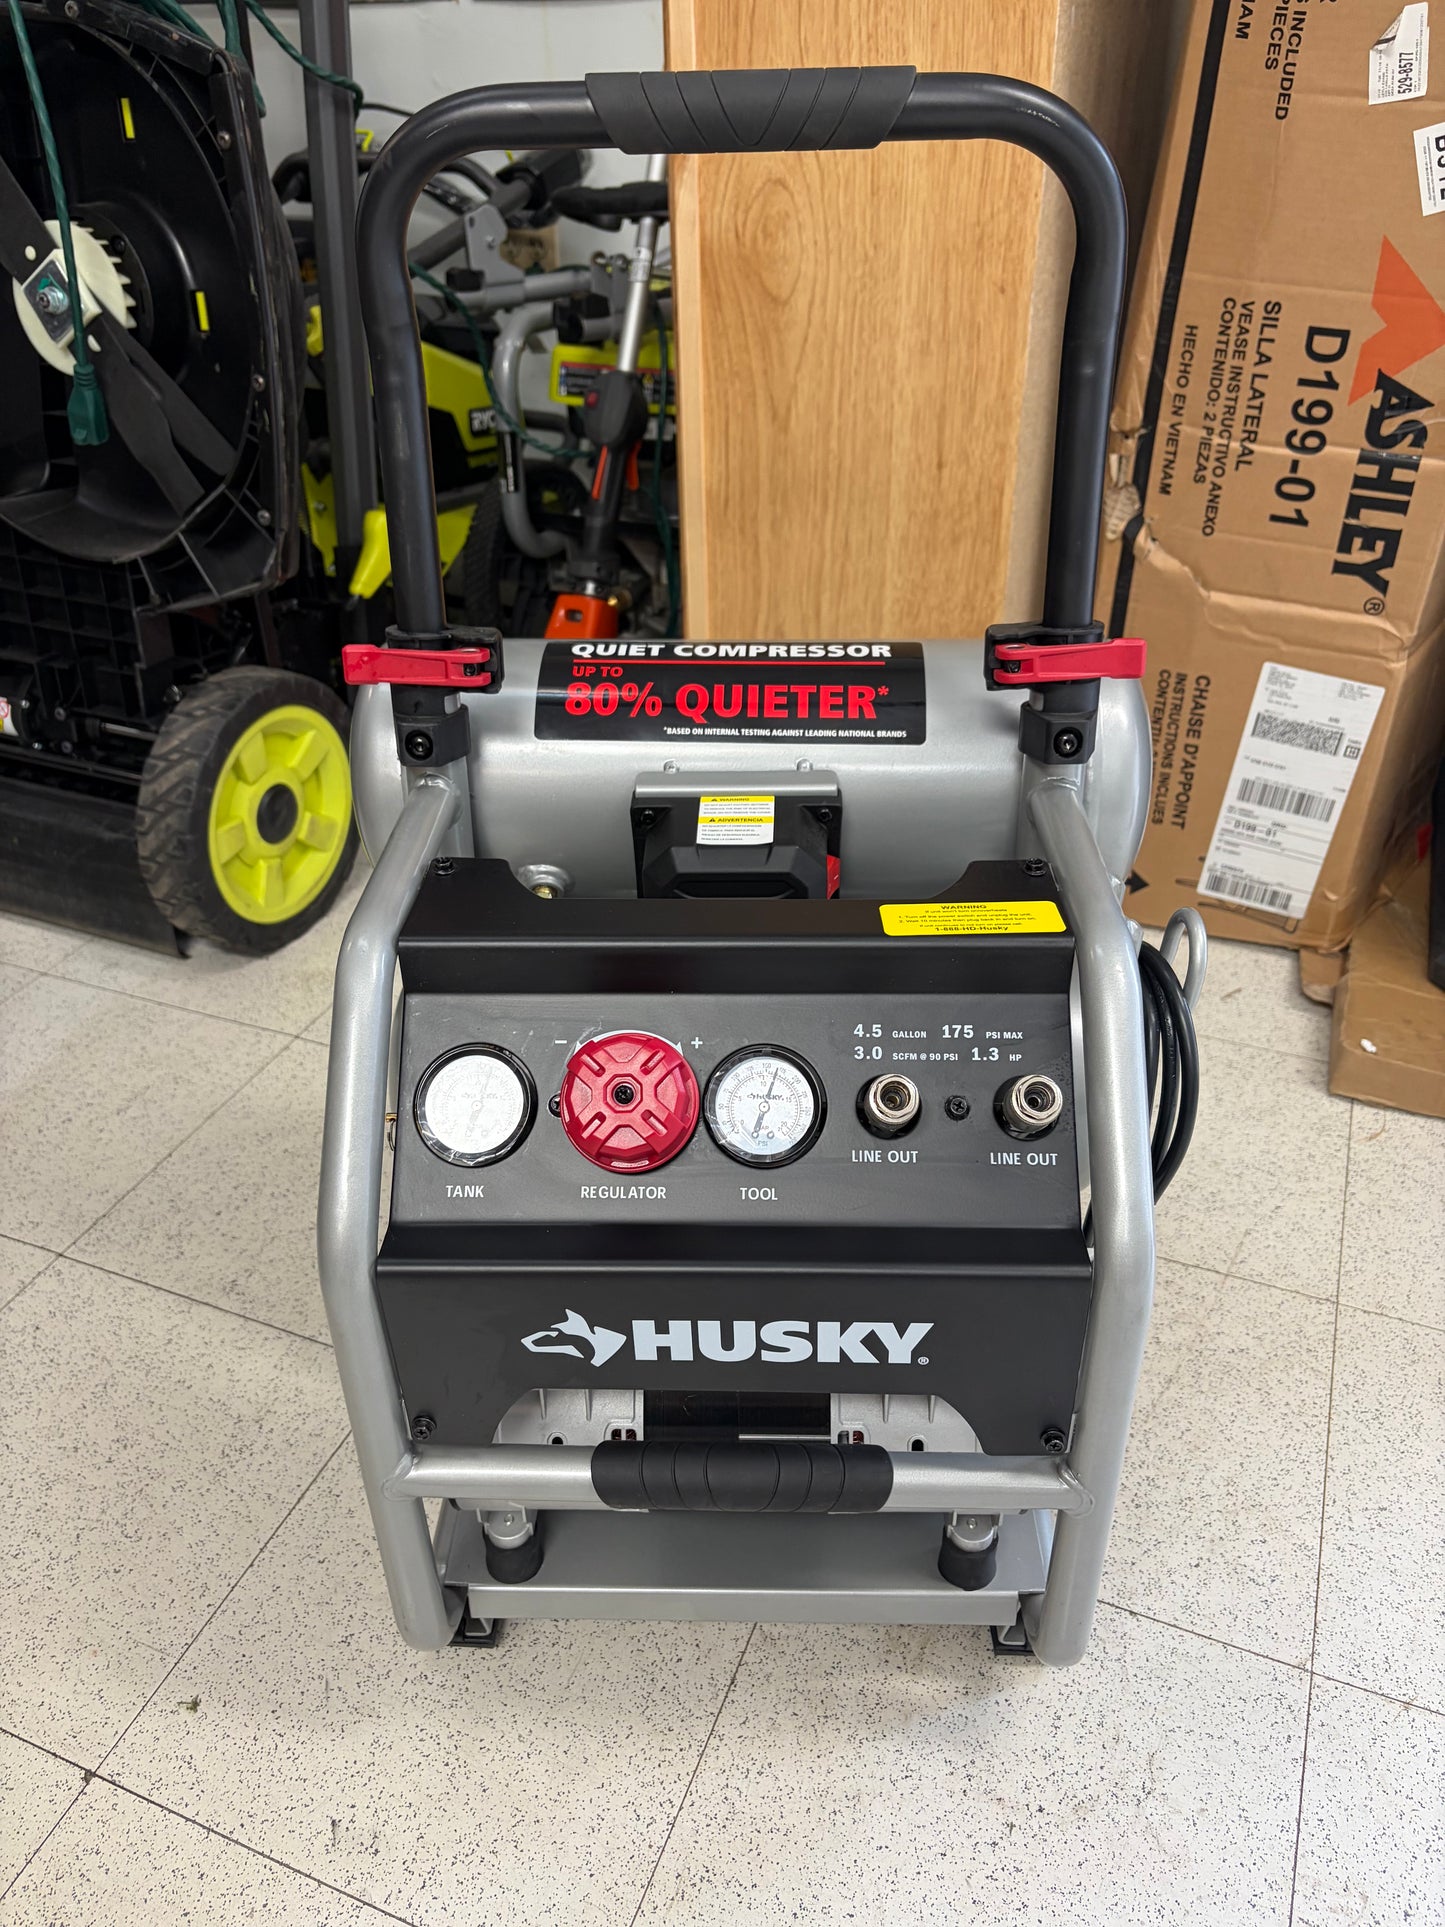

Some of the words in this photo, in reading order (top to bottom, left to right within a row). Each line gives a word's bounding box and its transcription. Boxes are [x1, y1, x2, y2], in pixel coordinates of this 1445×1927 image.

[1275, 10, 1307, 121] INCLUDED
[1397, 52, 1414, 95] 529-8577
[1207, 297, 1236, 409] CONTENIDO:
[1234, 301, 1255, 360] VEASE
[1256, 299, 1282, 367] SILLA
[1176, 325, 1198, 388] HECHO
[1171, 393, 1187, 417] EN
[1203, 411, 1217, 421] 2
[1211, 365, 1244, 479] INSTRUCTIVO
[1234, 374, 1269, 472] LATERAL
[1268, 326, 1350, 528] D199-01
[1158, 421, 1183, 496] VIETNAM
[1193, 425, 1214, 484] PIEZAS
[1201, 482, 1221, 537] ANEXO
[571, 643, 665, 659] QUIET
[673, 644, 892, 659] COMPRESSOR
[572, 666, 597, 678] UP
[600, 666, 624, 678] TO
[564, 681, 663, 719] 80%
[1160, 672, 1188, 769] INSTRUCTIONS
[1186, 675, 1211, 740] CHAISE
[704, 728, 740, 736] INTERNAL
[741, 728, 771, 737] TESTING
[771, 729, 803, 737] AGAINST
[804, 729, 837, 737] LEADING
[838, 729, 876, 738] NATIONAL
[876, 730, 907, 738] BRANDS
[1171, 743, 1199, 830] D'APPOINT
[853, 1023, 882, 1038] 4.5
[892, 1030, 927, 1039] GALLON
[942, 1025, 974, 1039] 175
[985, 1031, 1001, 1040] PSI
[1003, 1031, 1023, 1040] MAX
[854, 1046, 883, 1060] 3.0
[892, 1052, 918, 1061] SCFM
[919, 1053, 927, 1061] @
[929, 1053, 942, 1061] 90
[943, 1053, 959, 1061] PSI
[971, 1047, 1000, 1061] 1.3
[1009, 1054, 1022, 1062] HP
[851, 1150, 882, 1163] LINE
[887, 1151, 919, 1164] OUT
[990, 1152, 1021, 1165] LINE
[1026, 1153, 1058, 1166] OUT
[445, 1184, 485, 1198] TANK
[580, 1185, 667, 1200] REGULATOR
[739, 1186, 779, 1201] TOOL
